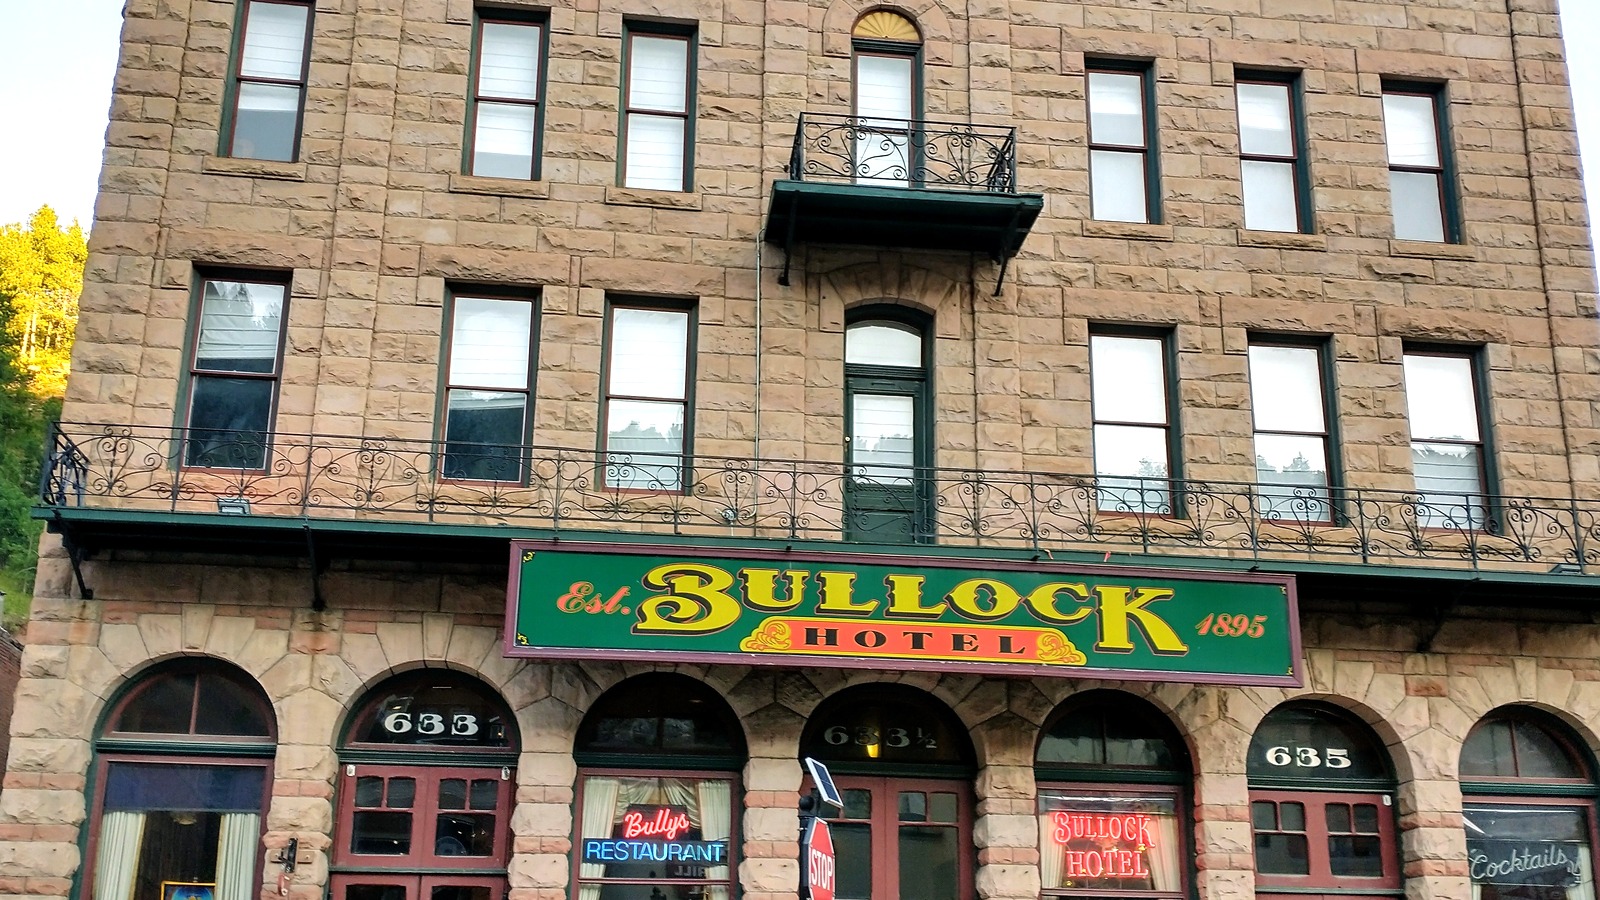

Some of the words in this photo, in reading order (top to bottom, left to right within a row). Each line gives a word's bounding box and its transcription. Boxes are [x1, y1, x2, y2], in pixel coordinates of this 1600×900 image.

[557, 581, 631, 615] Est.
[631, 562, 1189, 656] BULLOCK
[1195, 613, 1268, 638] 1895
[804, 627, 1026, 654] HOTEL
[384, 712, 479, 735] 633
[1266, 746, 1351, 768] 635
[624, 808, 690, 840] Bullys
[1054, 812, 1155, 847] BULLOCK
[586, 841, 725, 862] RESTAURANT
[1066, 850, 1149, 877] HOTEL
[1469, 844, 1568, 879] Cocktails
[811, 848, 833, 891] STOP
